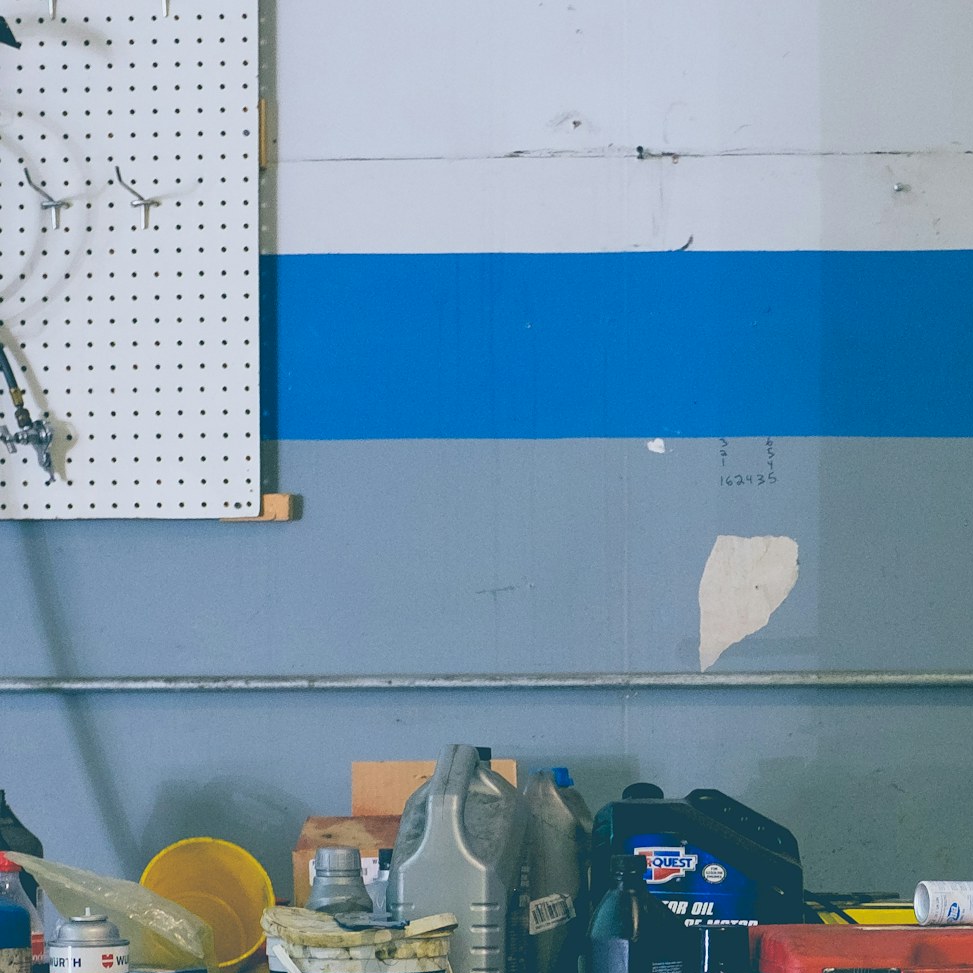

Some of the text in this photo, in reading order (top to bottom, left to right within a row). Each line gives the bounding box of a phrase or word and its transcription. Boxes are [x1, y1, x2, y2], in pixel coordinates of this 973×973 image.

[767, 447, 775, 459] 5
[646, 857, 693, 868] QUEST
[661, 900, 715, 916] OR OIL
